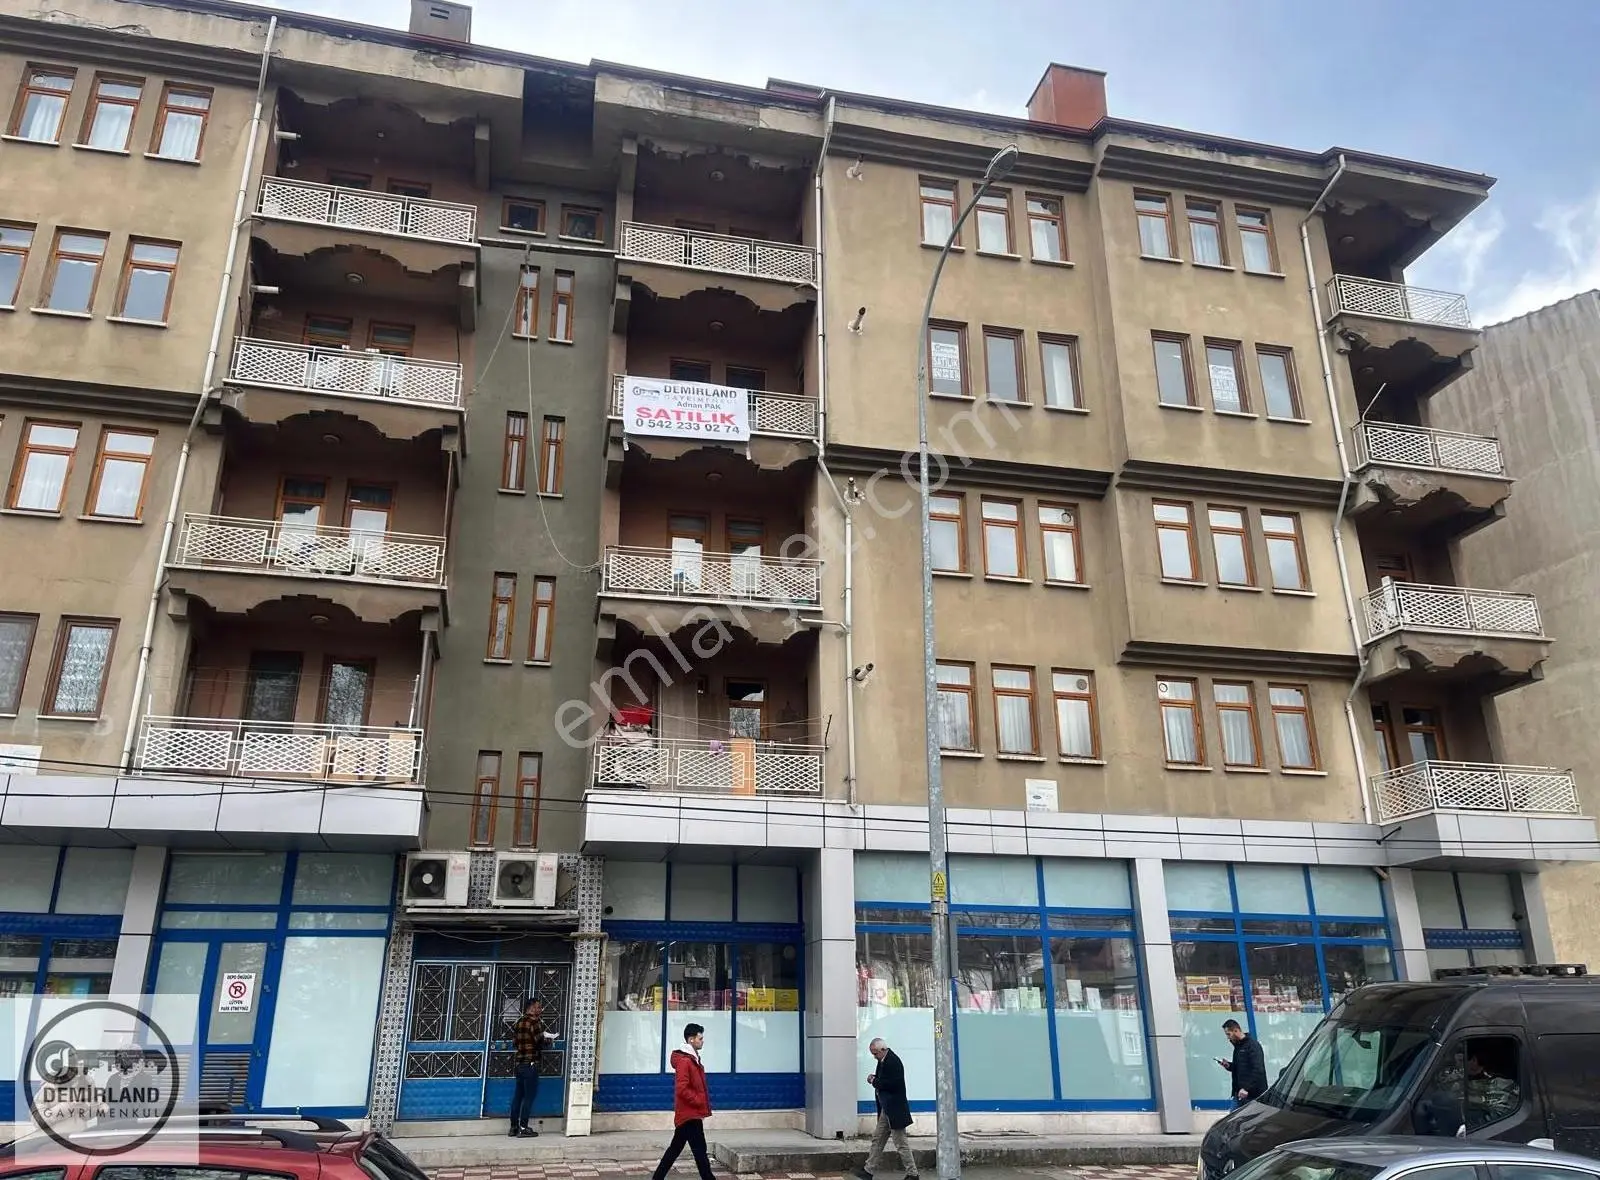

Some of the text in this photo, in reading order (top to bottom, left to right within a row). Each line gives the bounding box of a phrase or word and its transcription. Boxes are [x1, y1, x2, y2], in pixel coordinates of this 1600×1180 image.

[677, 401, 721, 410] Adnan PAK
[636, 407, 736, 426] SATILIK
[635, 418, 740, 434] 0 542 233 02 74
